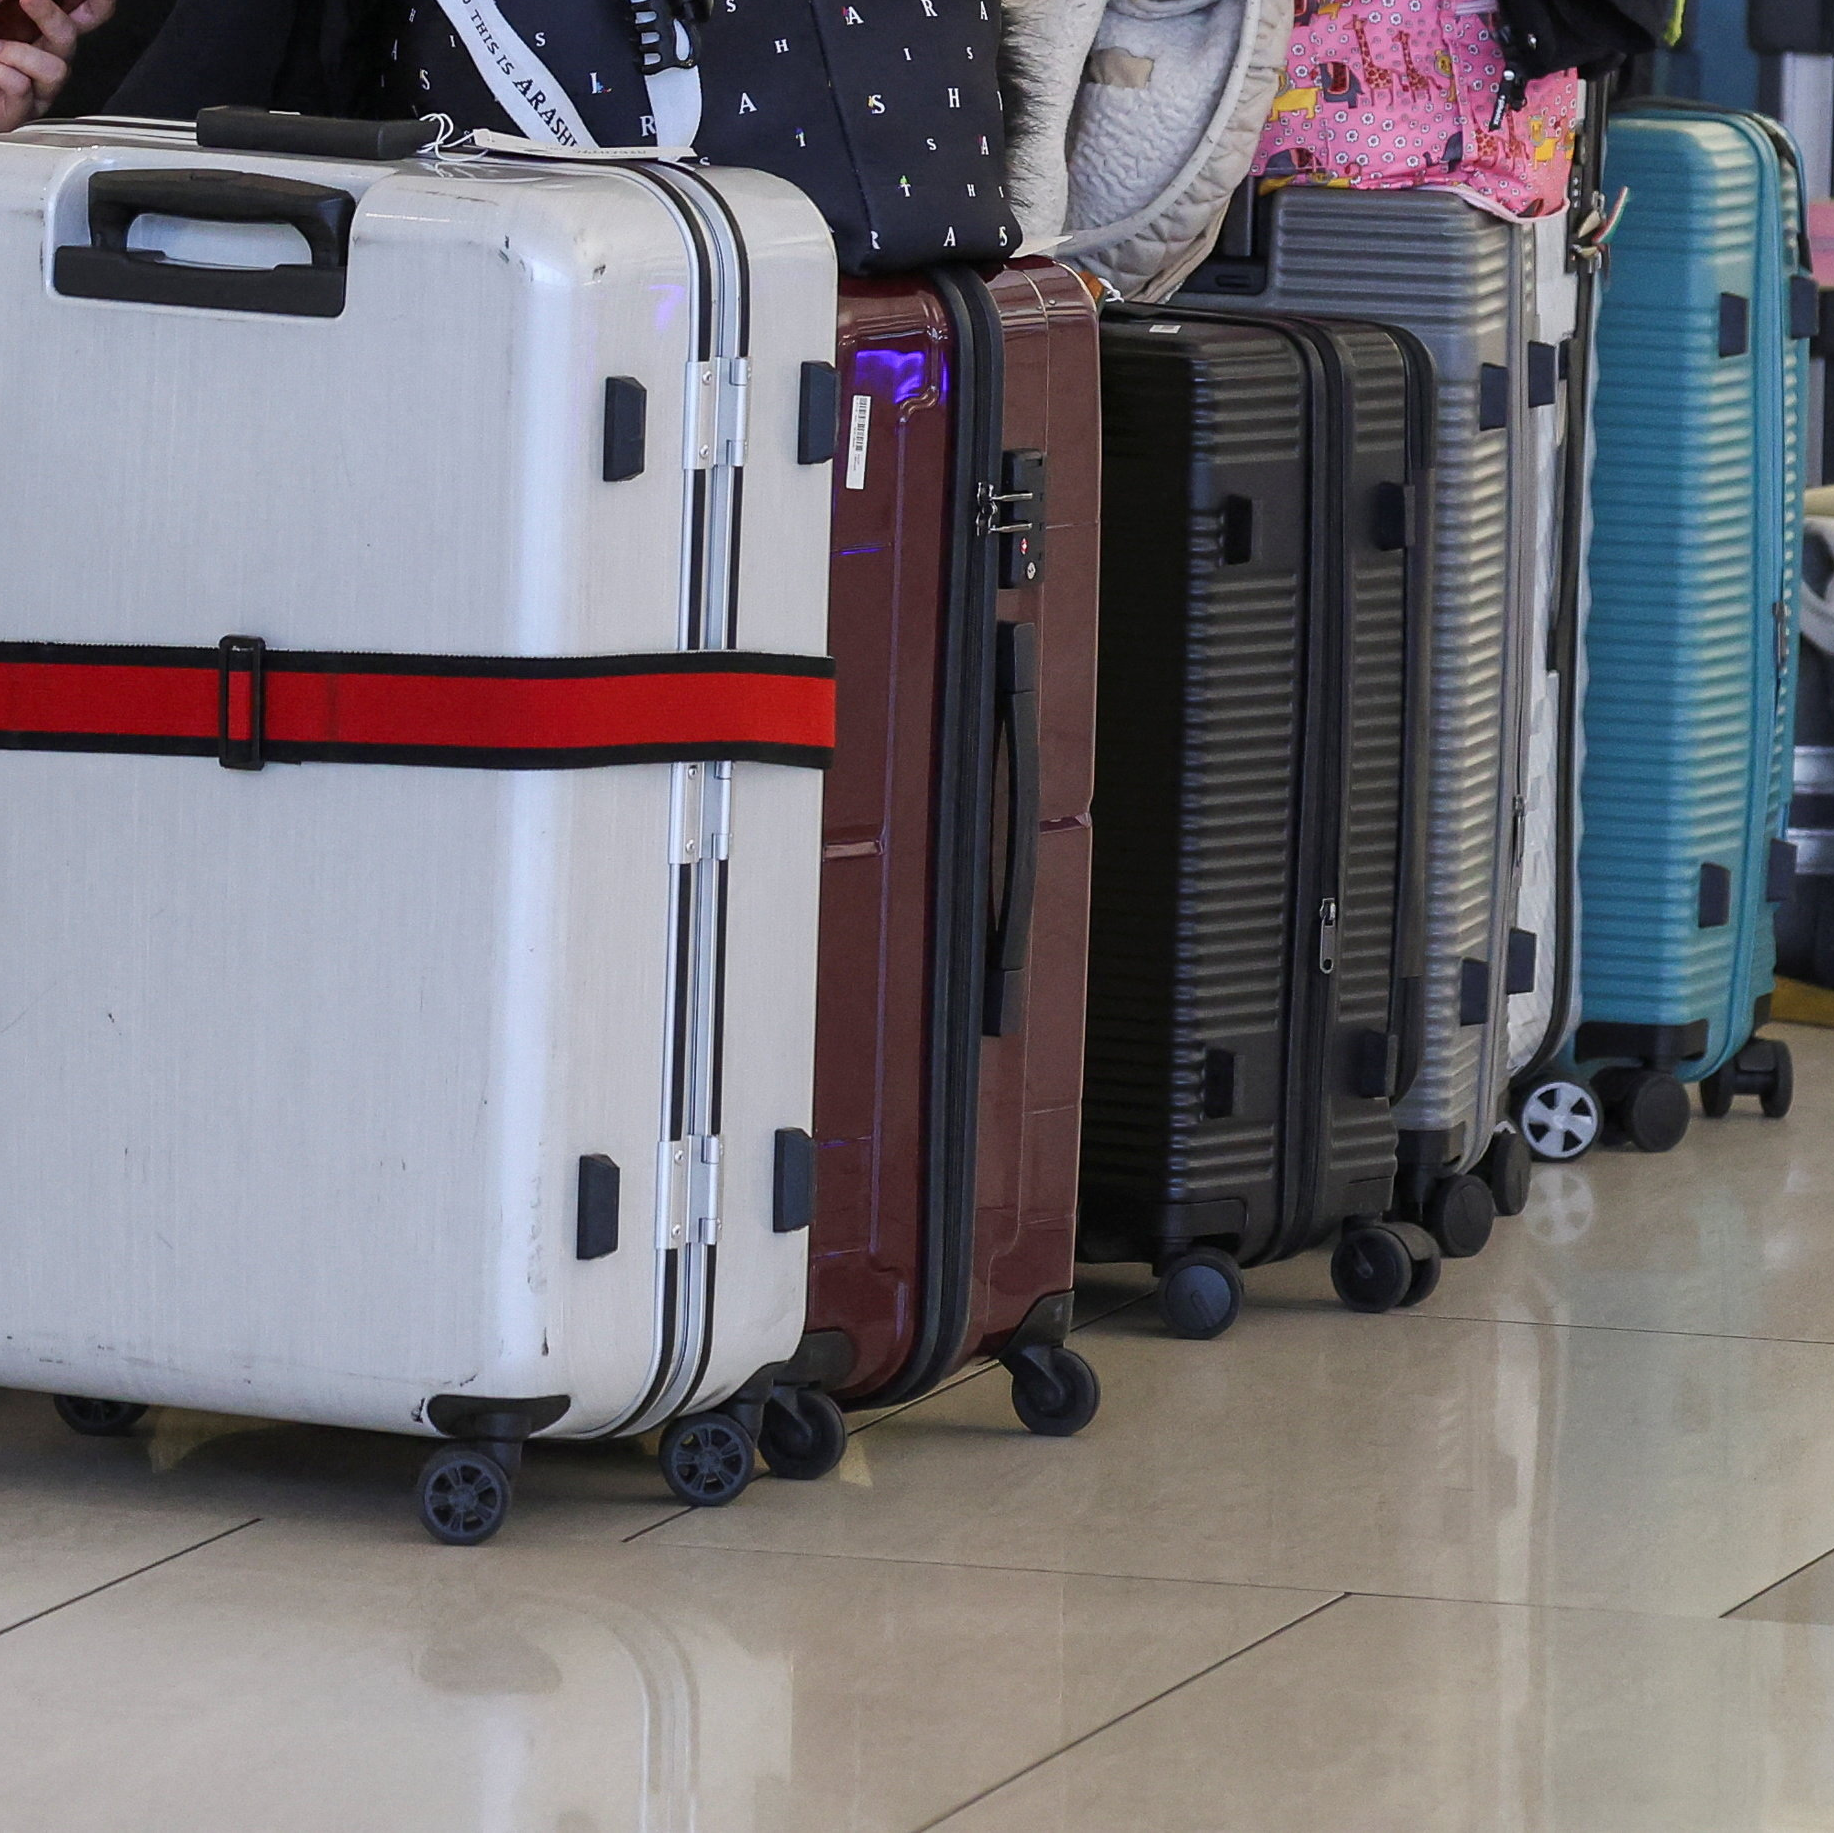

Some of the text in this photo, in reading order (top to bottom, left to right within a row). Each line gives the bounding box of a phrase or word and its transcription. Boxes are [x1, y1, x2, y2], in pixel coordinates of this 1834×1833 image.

[846, 6, 865, 26] A
[980, 0, 989, 21] A
[471, 9, 499, 55] THIS
[496, 54, 515, 75] IS
[535, 32, 546, 47] S
[774, 38, 790, 54] H
[966, 46, 974, 60] S
[738, 92, 758, 115] A
[871, 94, 886, 115] S
[947, 87, 961, 108] H
[926, 138, 937, 151] S
[980, 135, 990, 156] A
[966, 183, 976, 198] H
[943, 226, 956, 247] A
